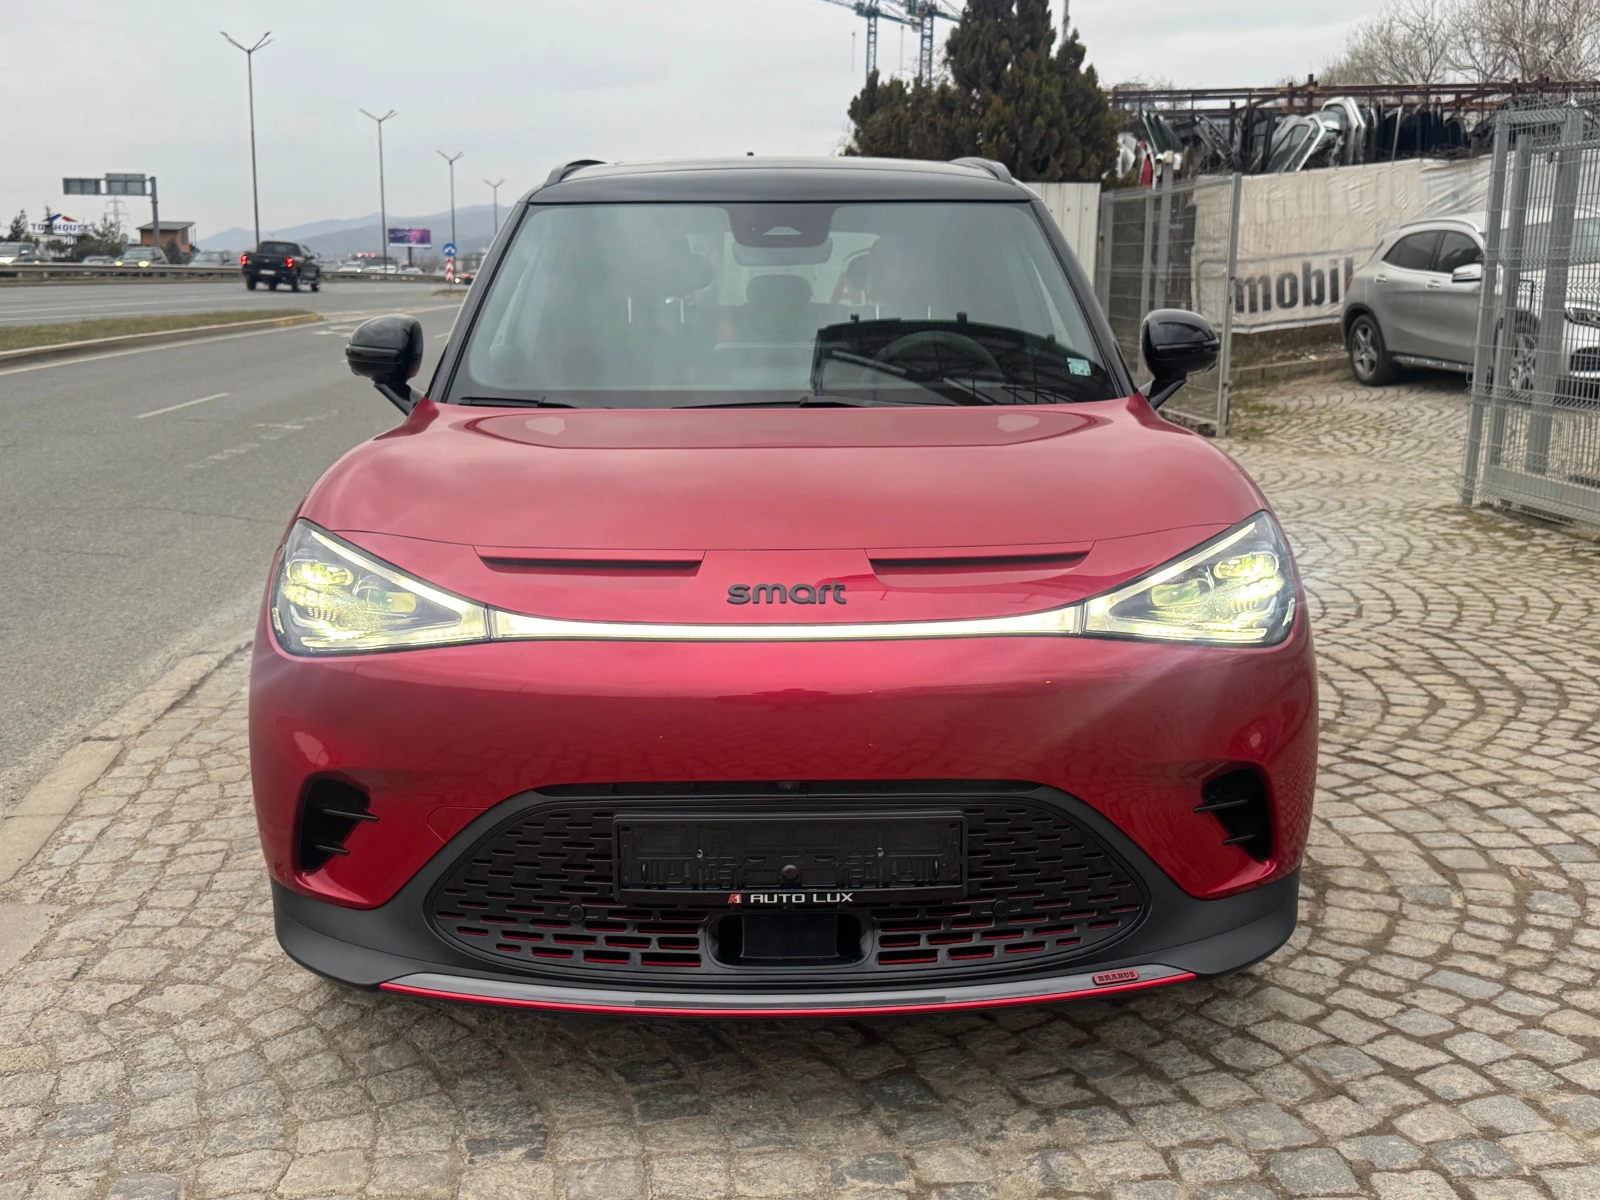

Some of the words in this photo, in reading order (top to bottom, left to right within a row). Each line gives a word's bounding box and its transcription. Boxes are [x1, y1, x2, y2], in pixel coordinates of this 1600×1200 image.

[727, 581, 847, 605] smart
[750, 893, 806, 904] AUTO
[812, 892, 854, 903] LUX
[1097, 970, 1136, 983] BRABUS
